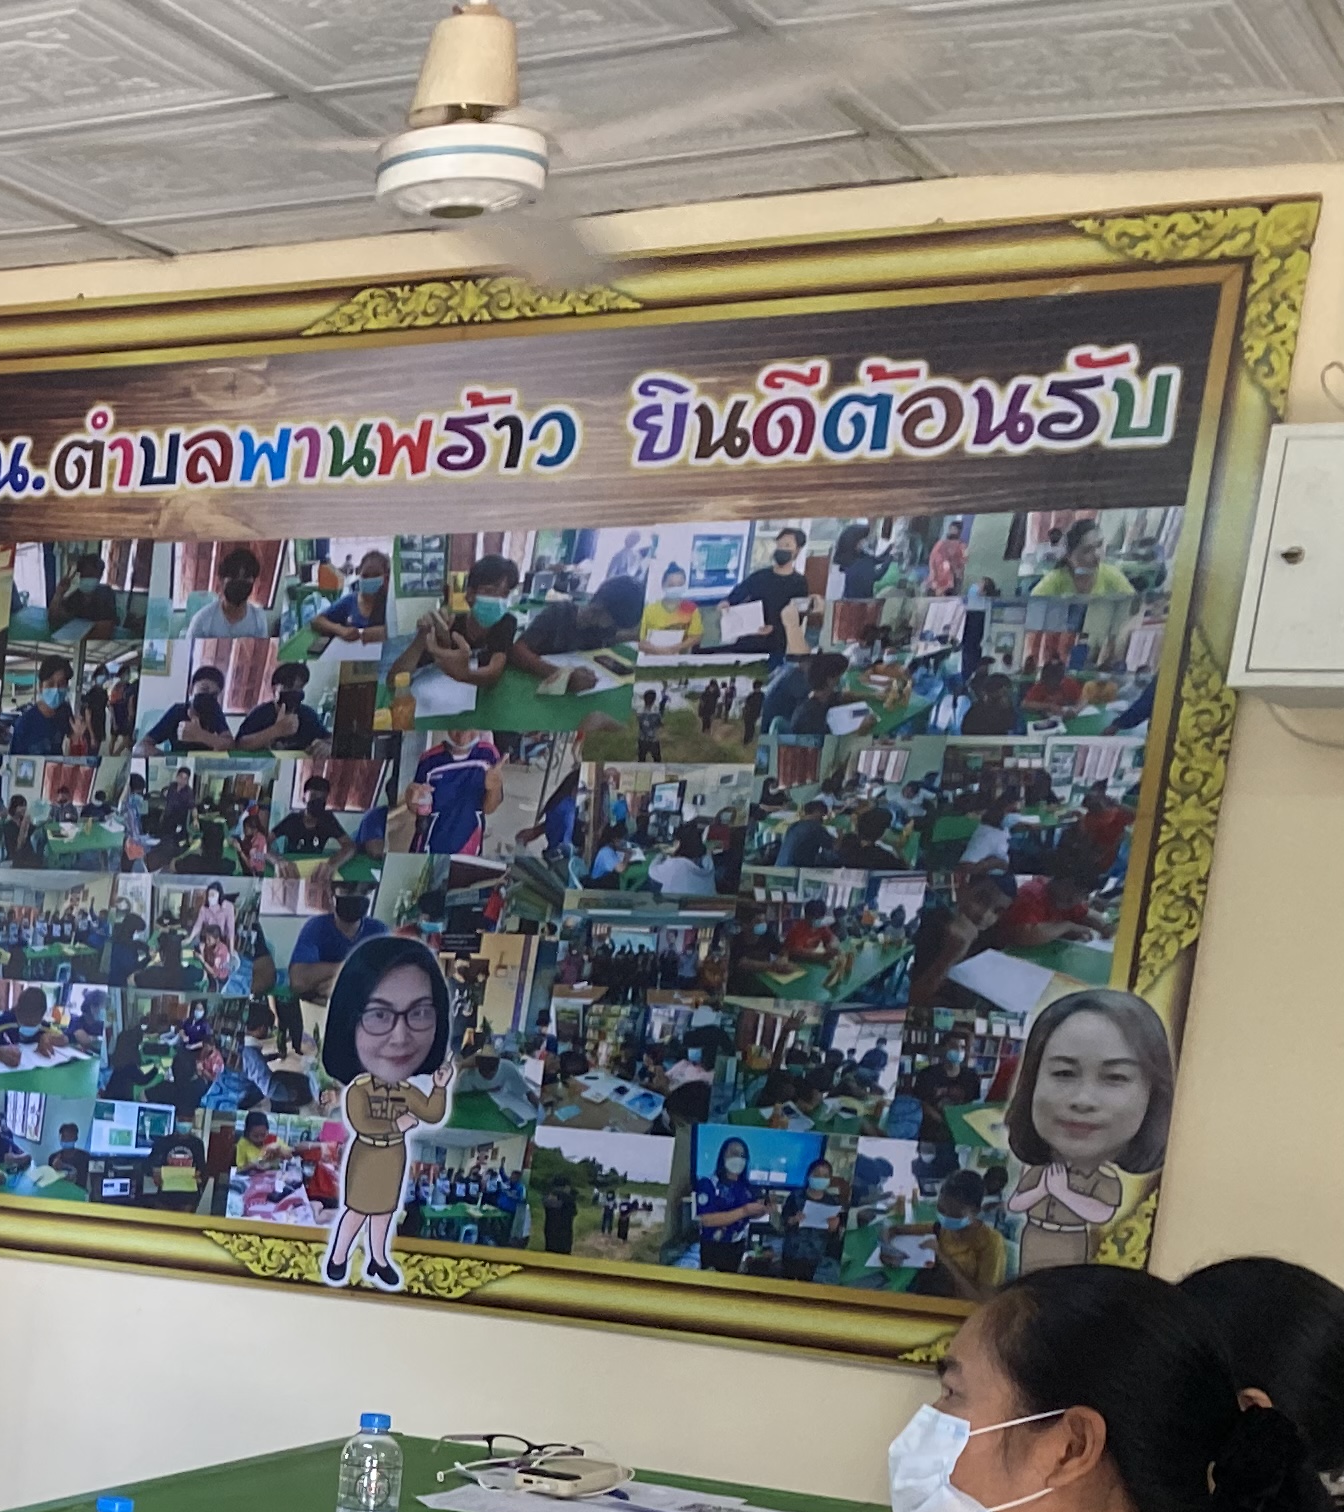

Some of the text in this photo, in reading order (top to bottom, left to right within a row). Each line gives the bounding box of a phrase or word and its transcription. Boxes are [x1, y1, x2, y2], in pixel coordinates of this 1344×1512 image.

[633, 350, 1174, 464] ยินดีต้อนรับ
